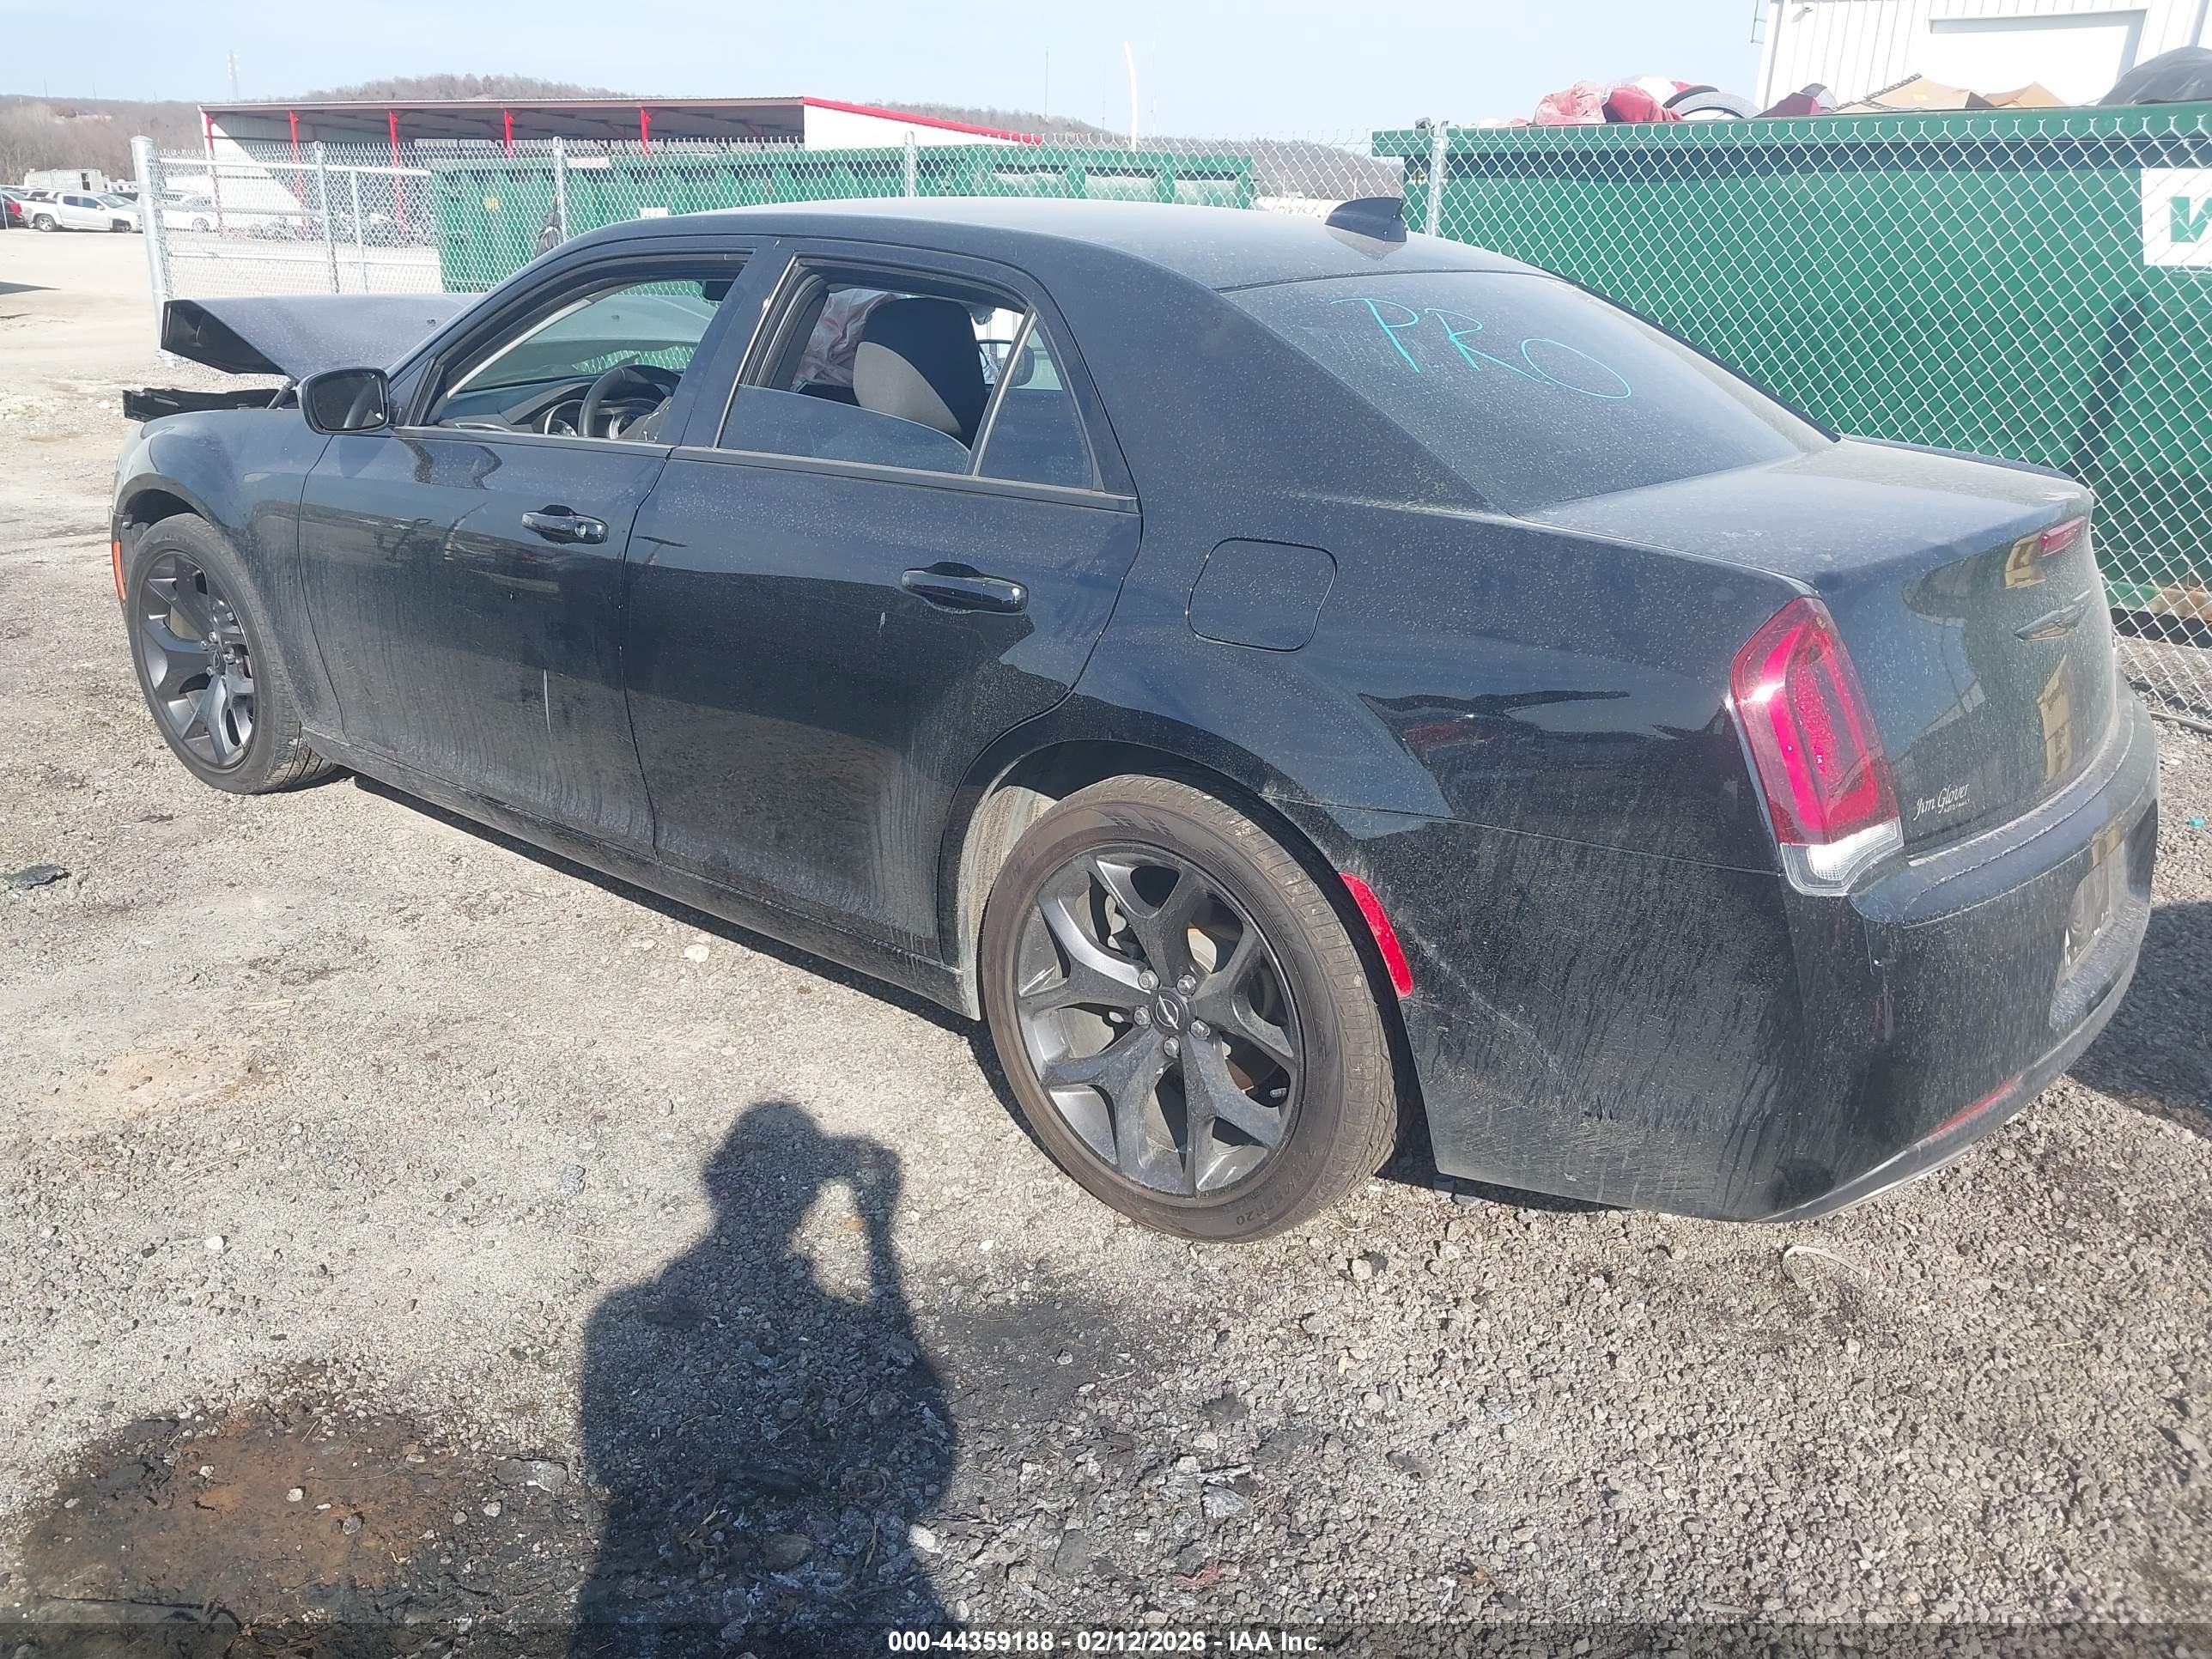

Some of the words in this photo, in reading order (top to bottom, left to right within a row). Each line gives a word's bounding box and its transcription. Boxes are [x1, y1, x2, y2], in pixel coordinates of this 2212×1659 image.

[1329, 297, 1632, 398] PRO
[1912, 798, 1936, 822] Jim
[1937, 783, 1970, 814] Glover
